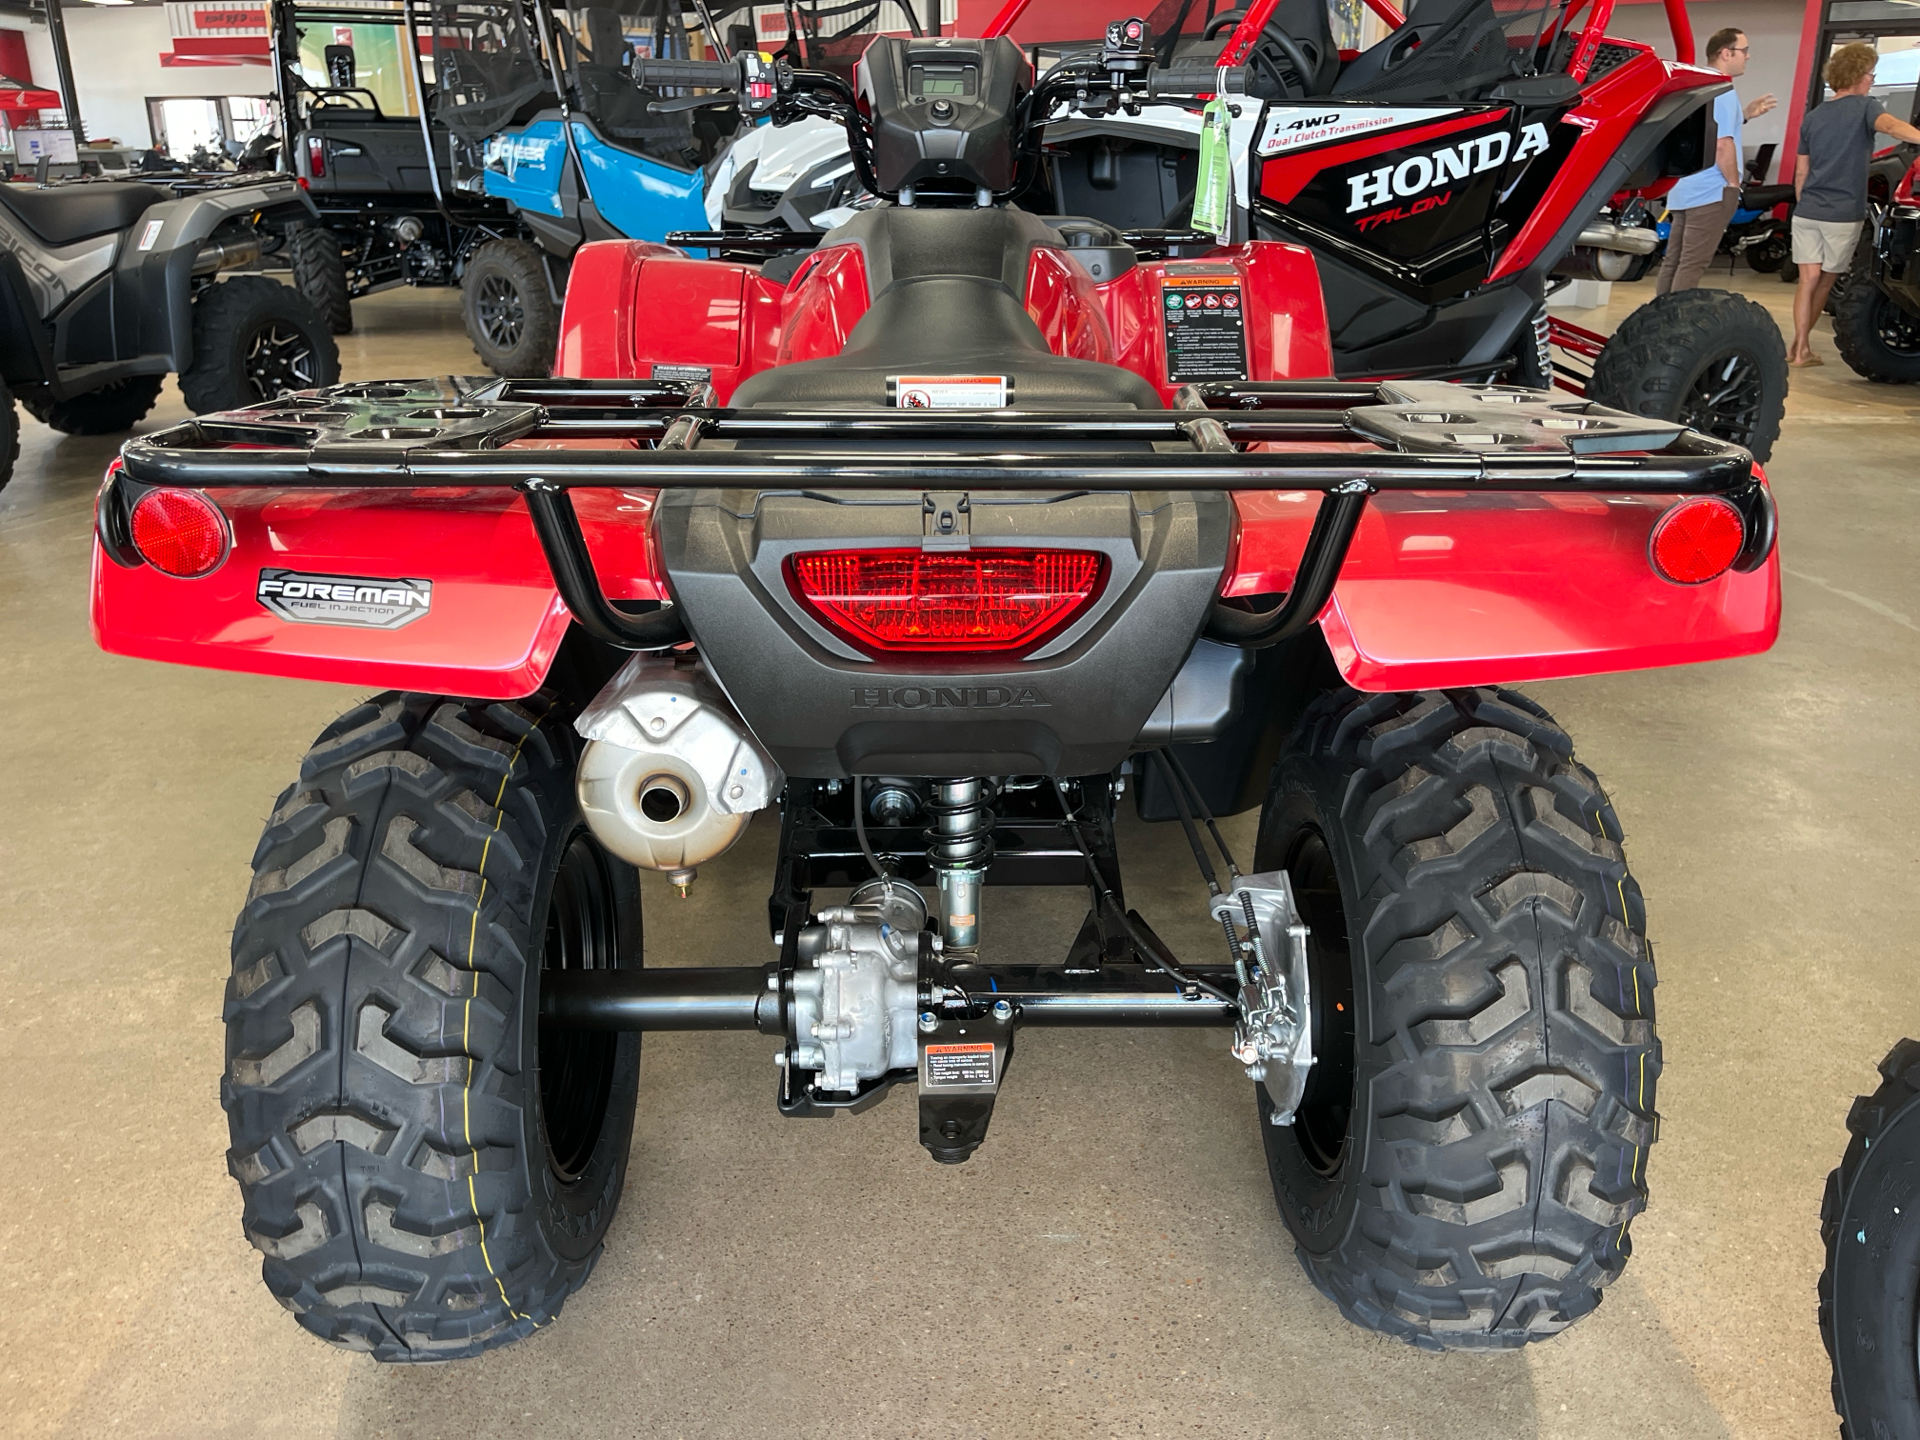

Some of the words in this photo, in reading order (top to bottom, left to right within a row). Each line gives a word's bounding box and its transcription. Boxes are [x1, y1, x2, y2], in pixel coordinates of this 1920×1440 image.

[226, 13, 247, 25] RED
[1267, 136, 1291, 149] Dual
[1294, 129, 1327, 143] Clutch
[1329, 116, 1394, 136] Transmission
[1273, 113, 1340, 135] i-4WD
[1346, 121, 1550, 214] HONDA
[1354, 190, 1452, 233] TALON
[258, 580, 431, 608] FOREMAN
[291, 601, 326, 610] FUEL
[329, 603, 395, 615] INJECTION
[850, 686, 1052, 710] HONDA
[944, 1045, 983, 1053] WARNING
